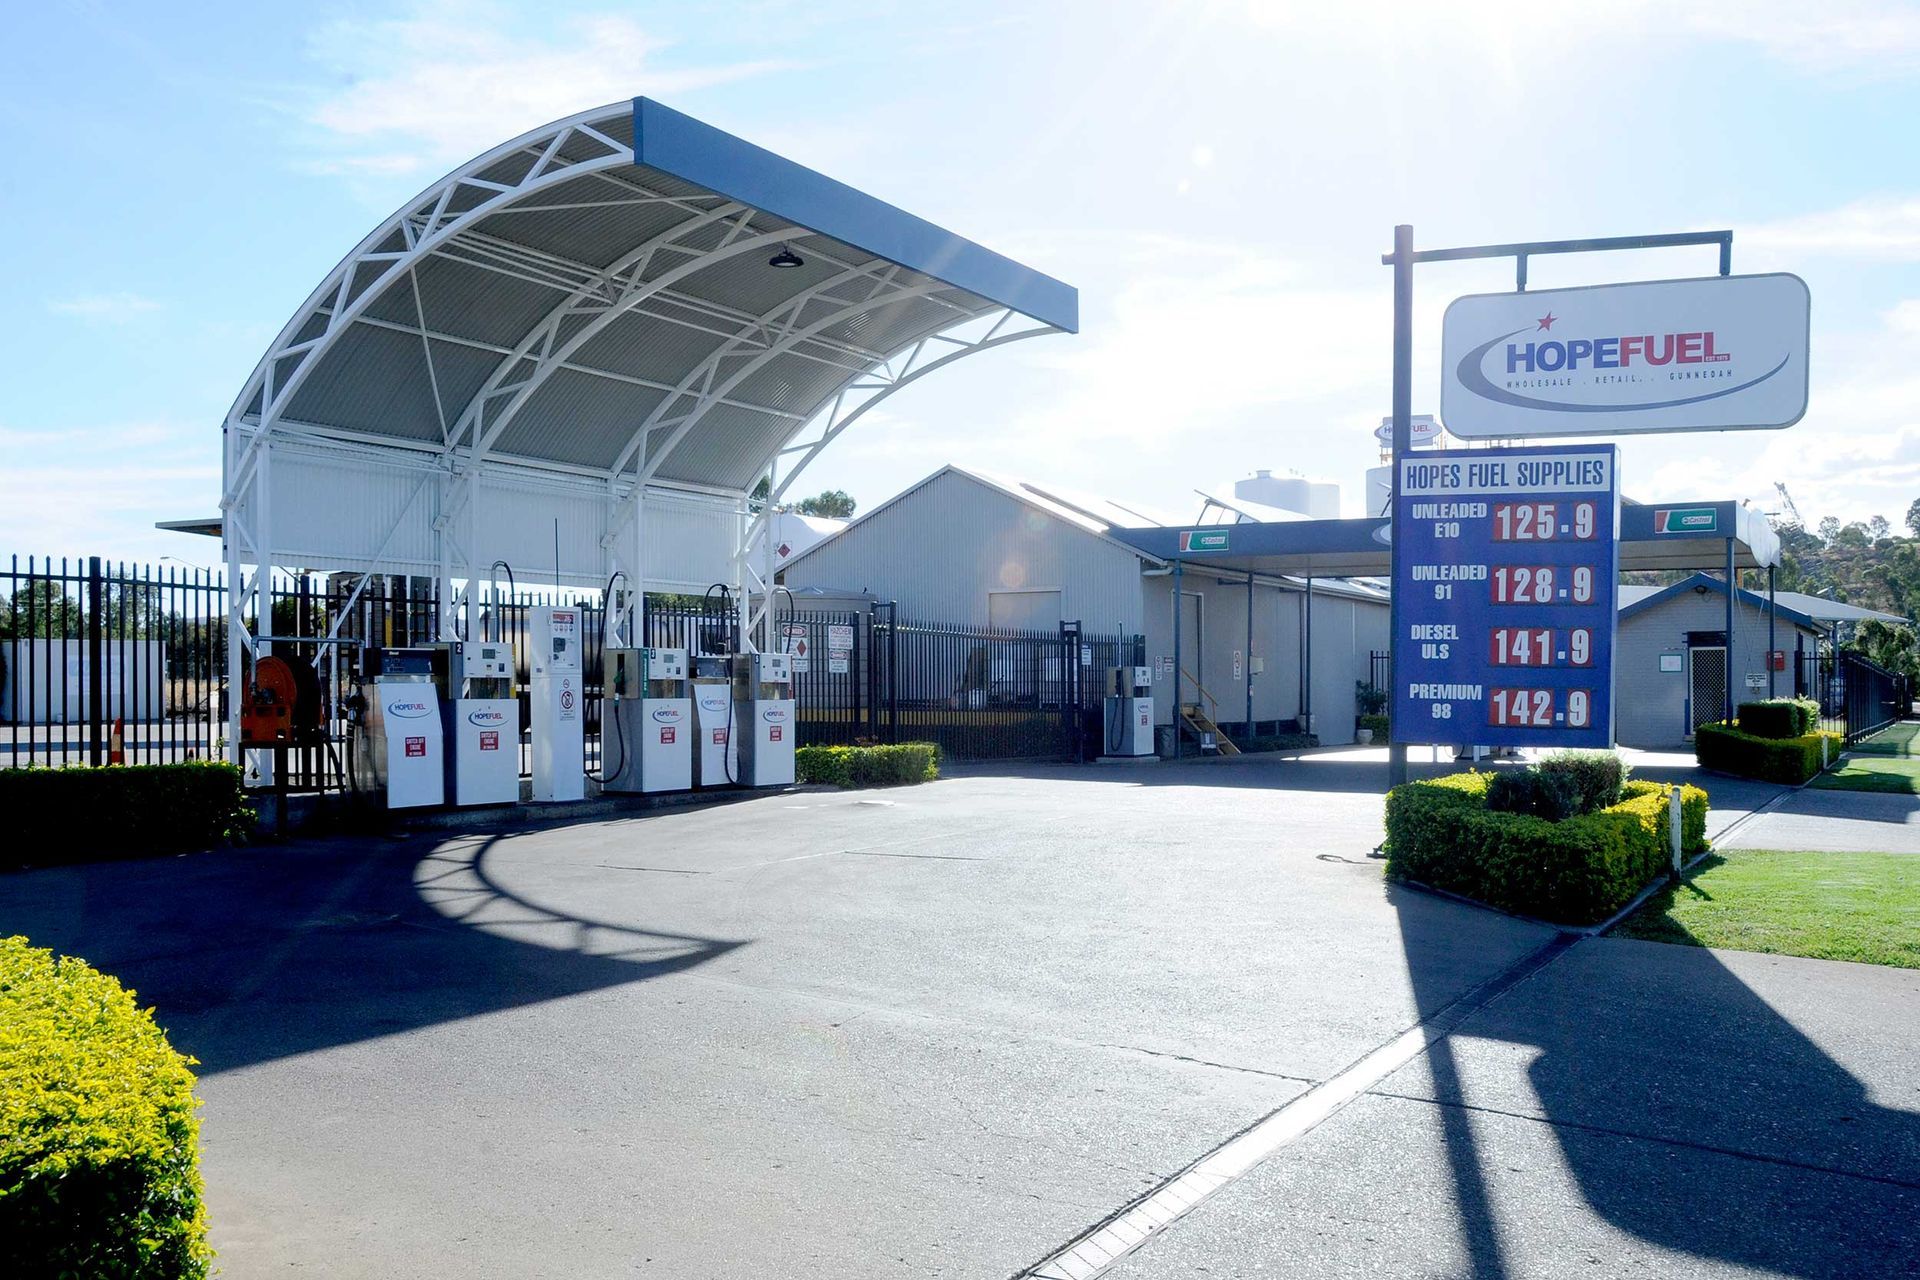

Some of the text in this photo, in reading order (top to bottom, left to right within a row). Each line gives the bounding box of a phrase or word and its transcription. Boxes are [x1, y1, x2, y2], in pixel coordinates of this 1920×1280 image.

[1507, 332, 1730, 373] HOPEFUEL
[1507, 378, 1571, 388] WHOLESALE
[1670, 369, 1732, 380] GUNNEDAH
[1384, 424, 1431, 433] HUEL
[1406, 460, 1604, 489] HOPES FUEL SUPPLIES
[1412, 503, 1593, 541] UNLEADED 125.9
[1434, 522, 1460, 538] E10
[1412, 565, 1592, 603] UNLEADED 128.9
[1434, 584, 1452, 600] 91
[457, 644, 462, 653] 2
[1411, 624, 1590, 665] DIESEL 141.9
[1421, 643, 1449, 659] ULS
[395, 703, 426, 711] HOPEFUEL
[1409, 684, 1588, 726] PREMIUM 142.9
[1432, 703, 1452, 719] 98
[474, 712, 503, 720] HOPEFUEL
